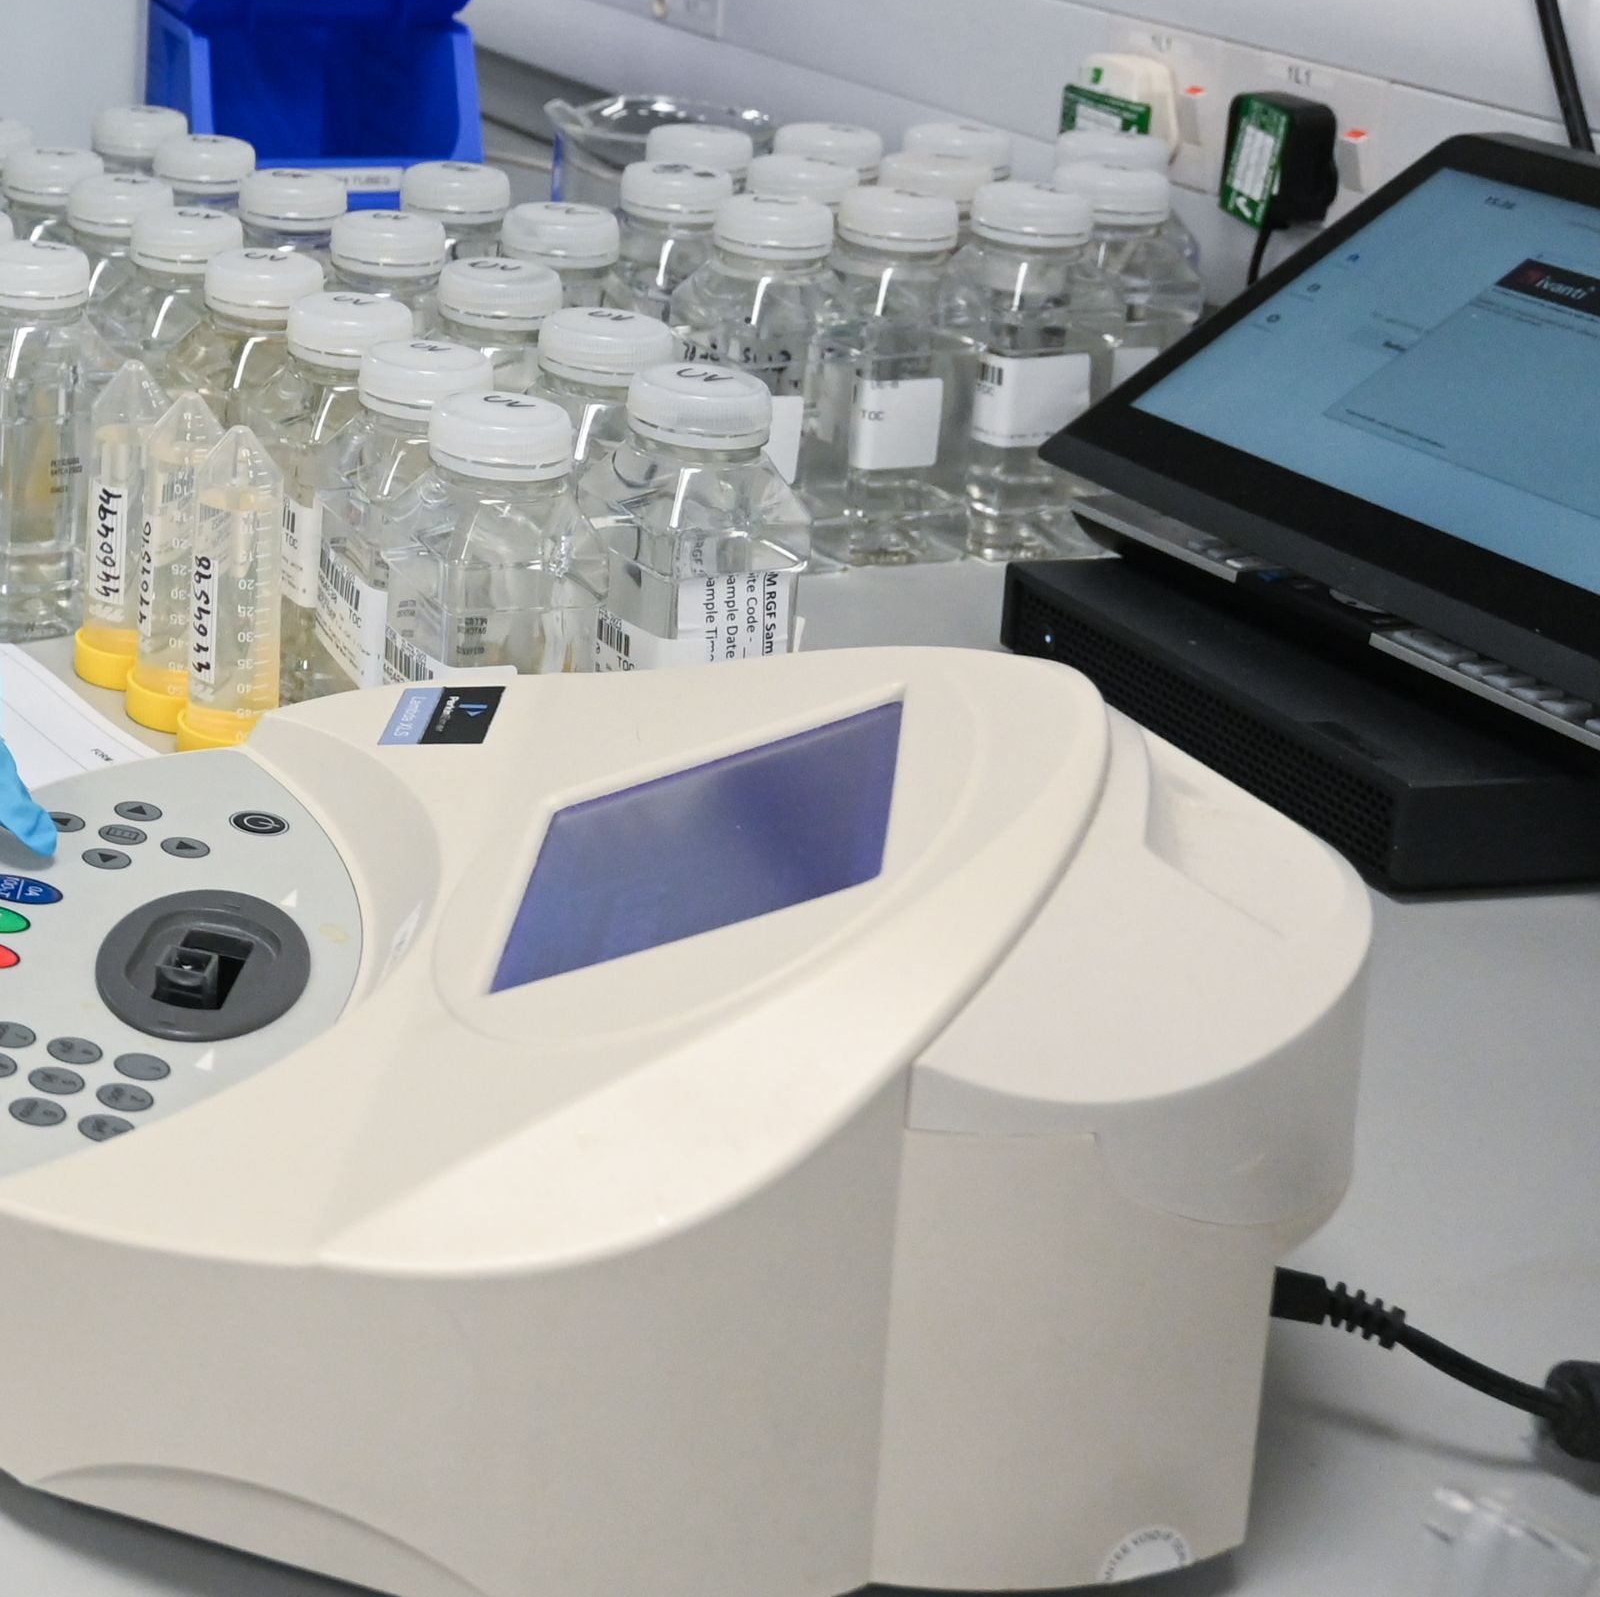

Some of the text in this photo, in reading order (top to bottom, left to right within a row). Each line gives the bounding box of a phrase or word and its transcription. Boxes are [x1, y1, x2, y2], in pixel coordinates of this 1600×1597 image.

[1534, 275, 1587, 301] ivanti
[861, 410, 885, 421] TOC
[93, 487, 123, 599] 4460494
[283, 533, 299, 550] TOC
[348, 609, 362, 629] TOC
[746, 597, 759, 634] Code
[765, 591, 777, 620] RGF
[237, 631, 255, 643] 30
[725, 625, 738, 659] Date
[393, 695, 427, 738] Lambda XLS
